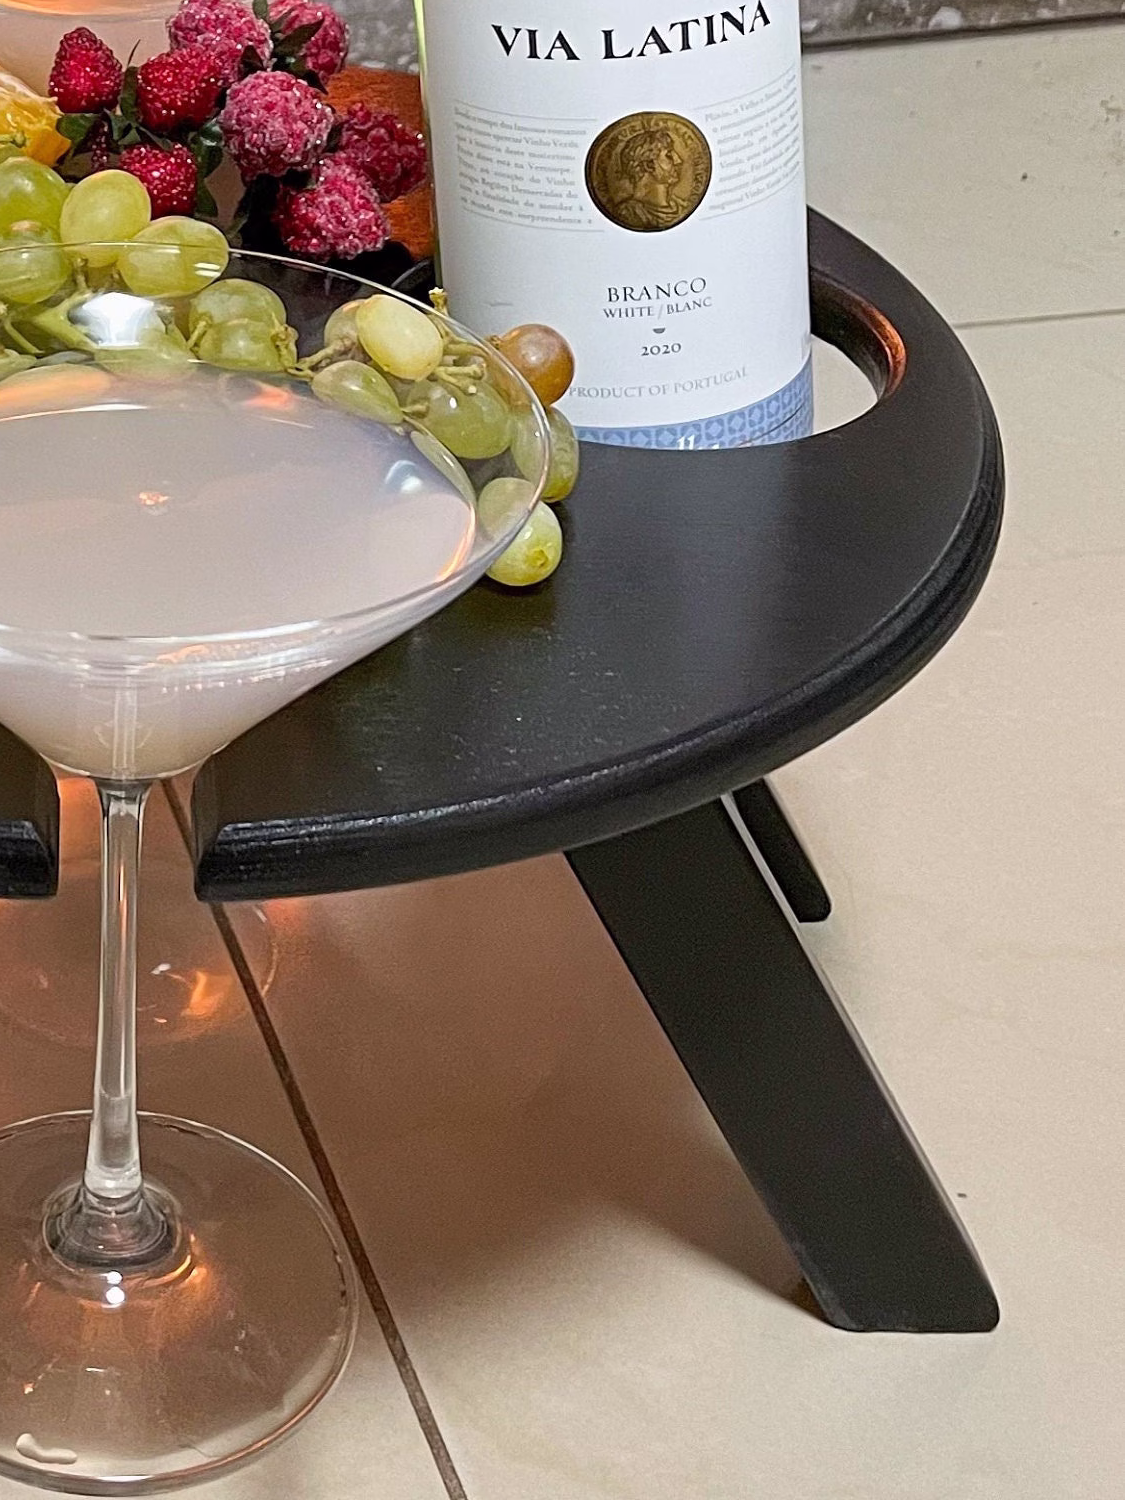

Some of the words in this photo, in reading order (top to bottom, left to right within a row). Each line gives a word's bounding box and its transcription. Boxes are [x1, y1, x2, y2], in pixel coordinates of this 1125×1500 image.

[490, 23, 581, 61] VIA
[600, 0, 772, 60] LATINA
[607, 277, 707, 303] BRANCO
[603, 305, 655, 320] WHITE
[666, 297, 713, 315] BLANC
[640, 342, 683, 357] 2020
[568, 385, 646, 400] PRODUCT
[648, 383, 671, 397] OF
[673, 367, 748, 393] PORTUGAL
